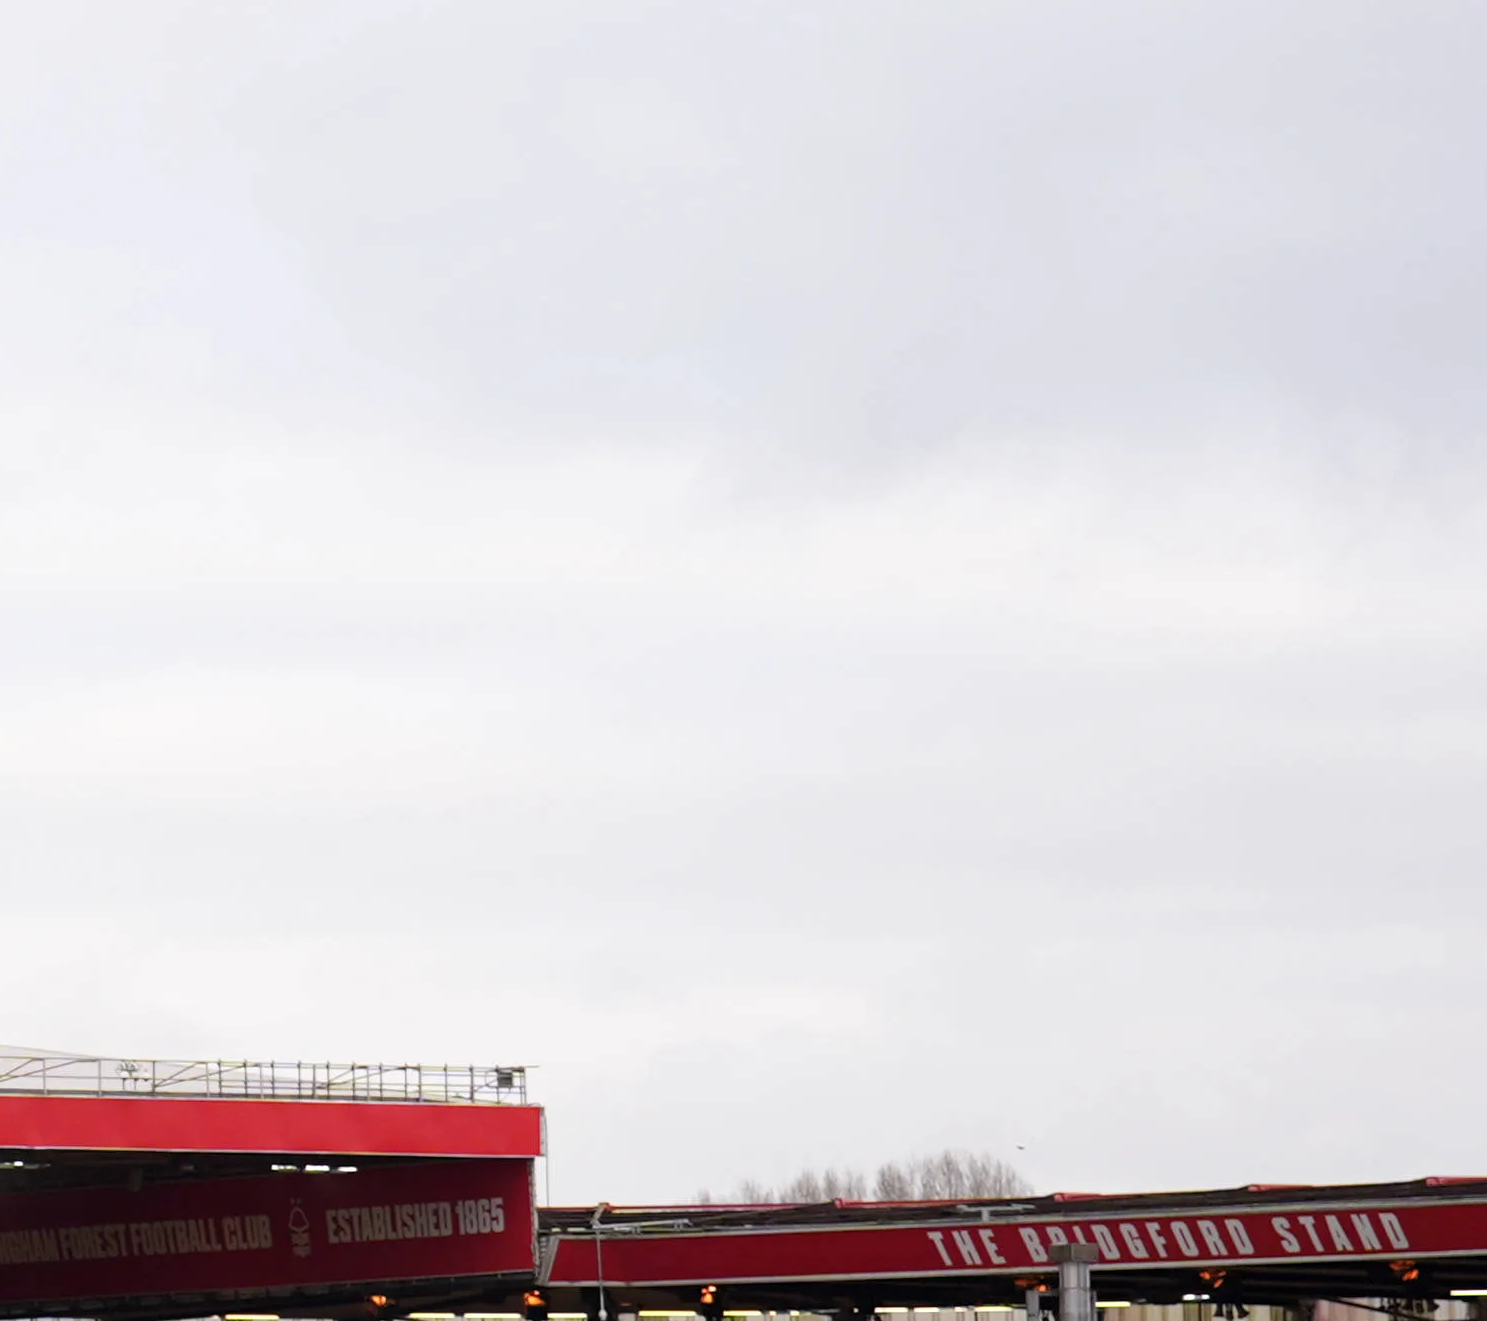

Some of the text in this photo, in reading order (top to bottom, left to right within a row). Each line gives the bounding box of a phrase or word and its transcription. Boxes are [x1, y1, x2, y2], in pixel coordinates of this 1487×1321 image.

[58, 1223, 127, 1261] FOREST
[129, 1217, 221, 1257] FOOTBALL
[221, 1214, 273, 1250] CLUB
[325, 1197, 505, 1244] ESTABLISHED 1865
[927, 1228, 1006, 1266] THE
[1271, 1212, 1410, 1254] STAND
